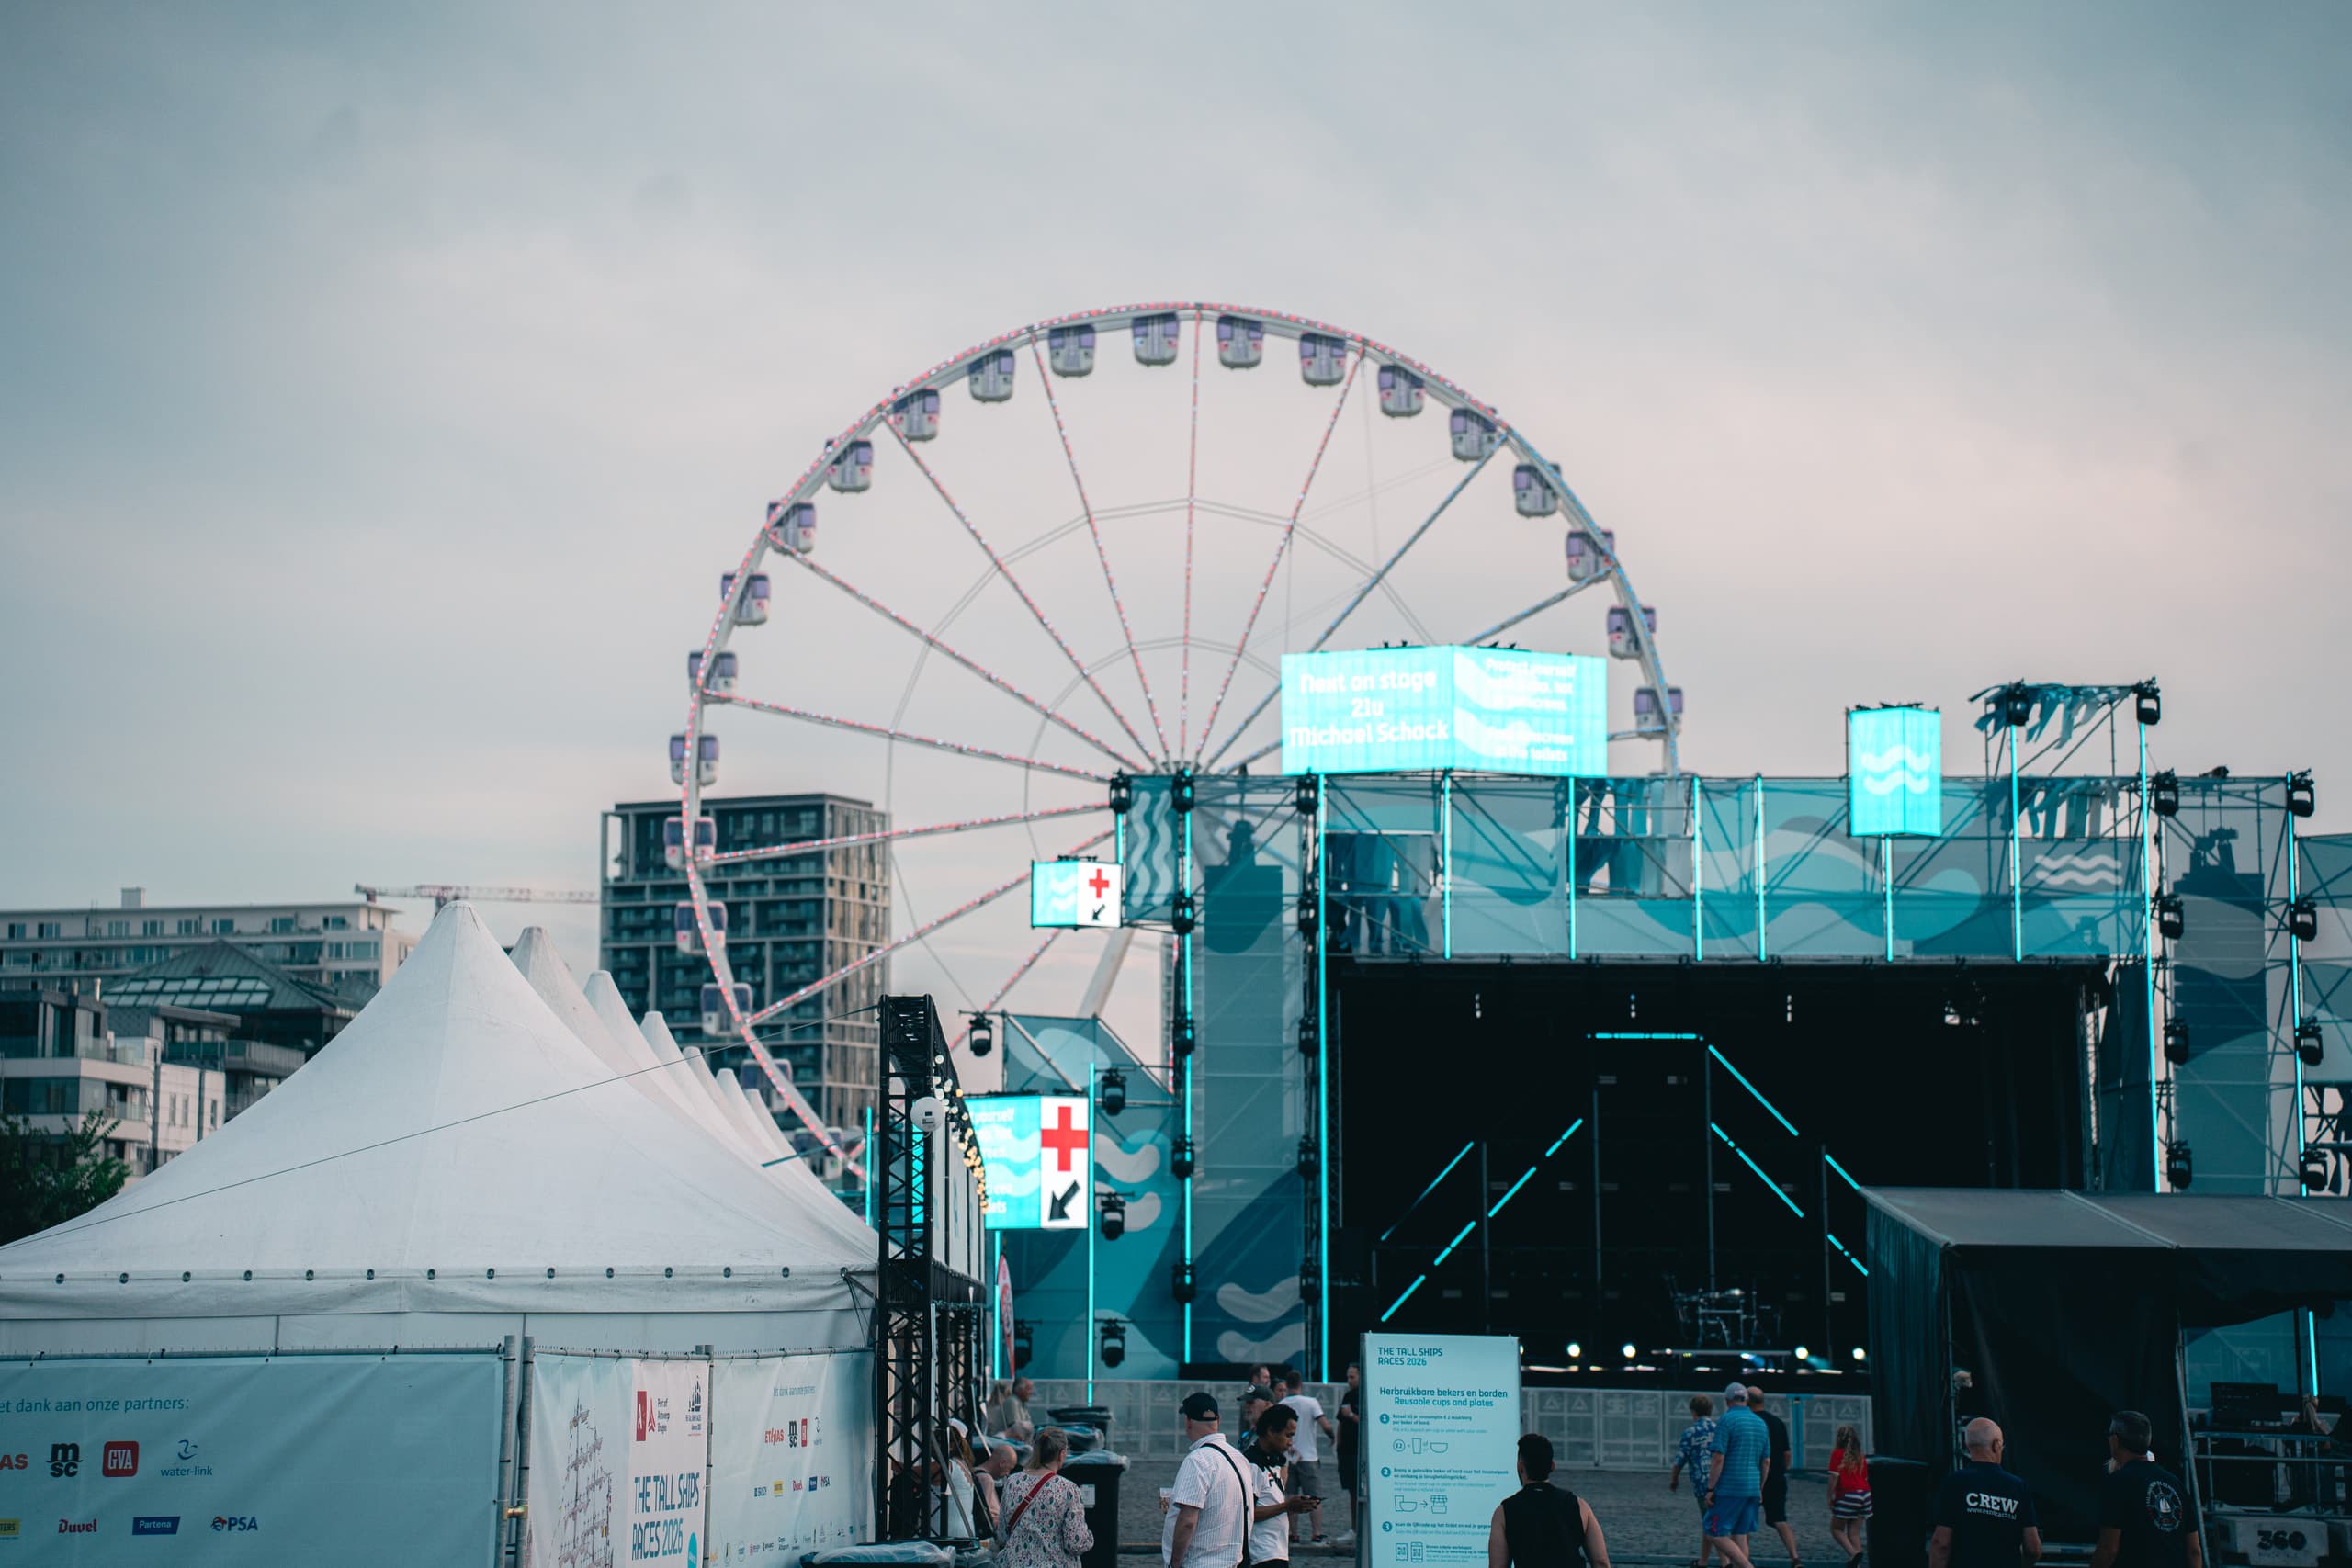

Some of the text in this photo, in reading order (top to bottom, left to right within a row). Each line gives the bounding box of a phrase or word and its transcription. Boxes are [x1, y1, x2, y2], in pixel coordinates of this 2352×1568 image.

[1350, 674, 1375, 692] on
[1379, 671, 1437, 693] stage
[1351, 696, 1385, 717] 21u
[1289, 723, 1374, 748] Michael
[1378, 1347, 1442, 1357] THE TALL SHIPS
[1378, 1357, 1427, 1367] RACES 2026
[1379, 1386, 1508, 1398] Herbruikbare bekers en borden
[16, 1398, 51, 1413] dank
[54, 1400, 82, 1412] aan
[86, 1399, 119, 1412] onze
[124, 1397, 189, 1414] partners:
[1394, 1397, 1494, 1408] Reusable cups and plates
[107, 1449, 133, 1470] GVA
[160, 1465, 213, 1477] water-link
[634, 1472, 700, 1514] THE TALL SHIPS
[1965, 1492, 2019, 1514] CREW
[58, 1518, 98, 1534] Duvel
[139, 1519, 172, 1529] Partena
[227, 1516, 259, 1531] PSA
[631, 1517, 684, 1561] RACES 2026
[2256, 1529, 2307, 1551] 360
